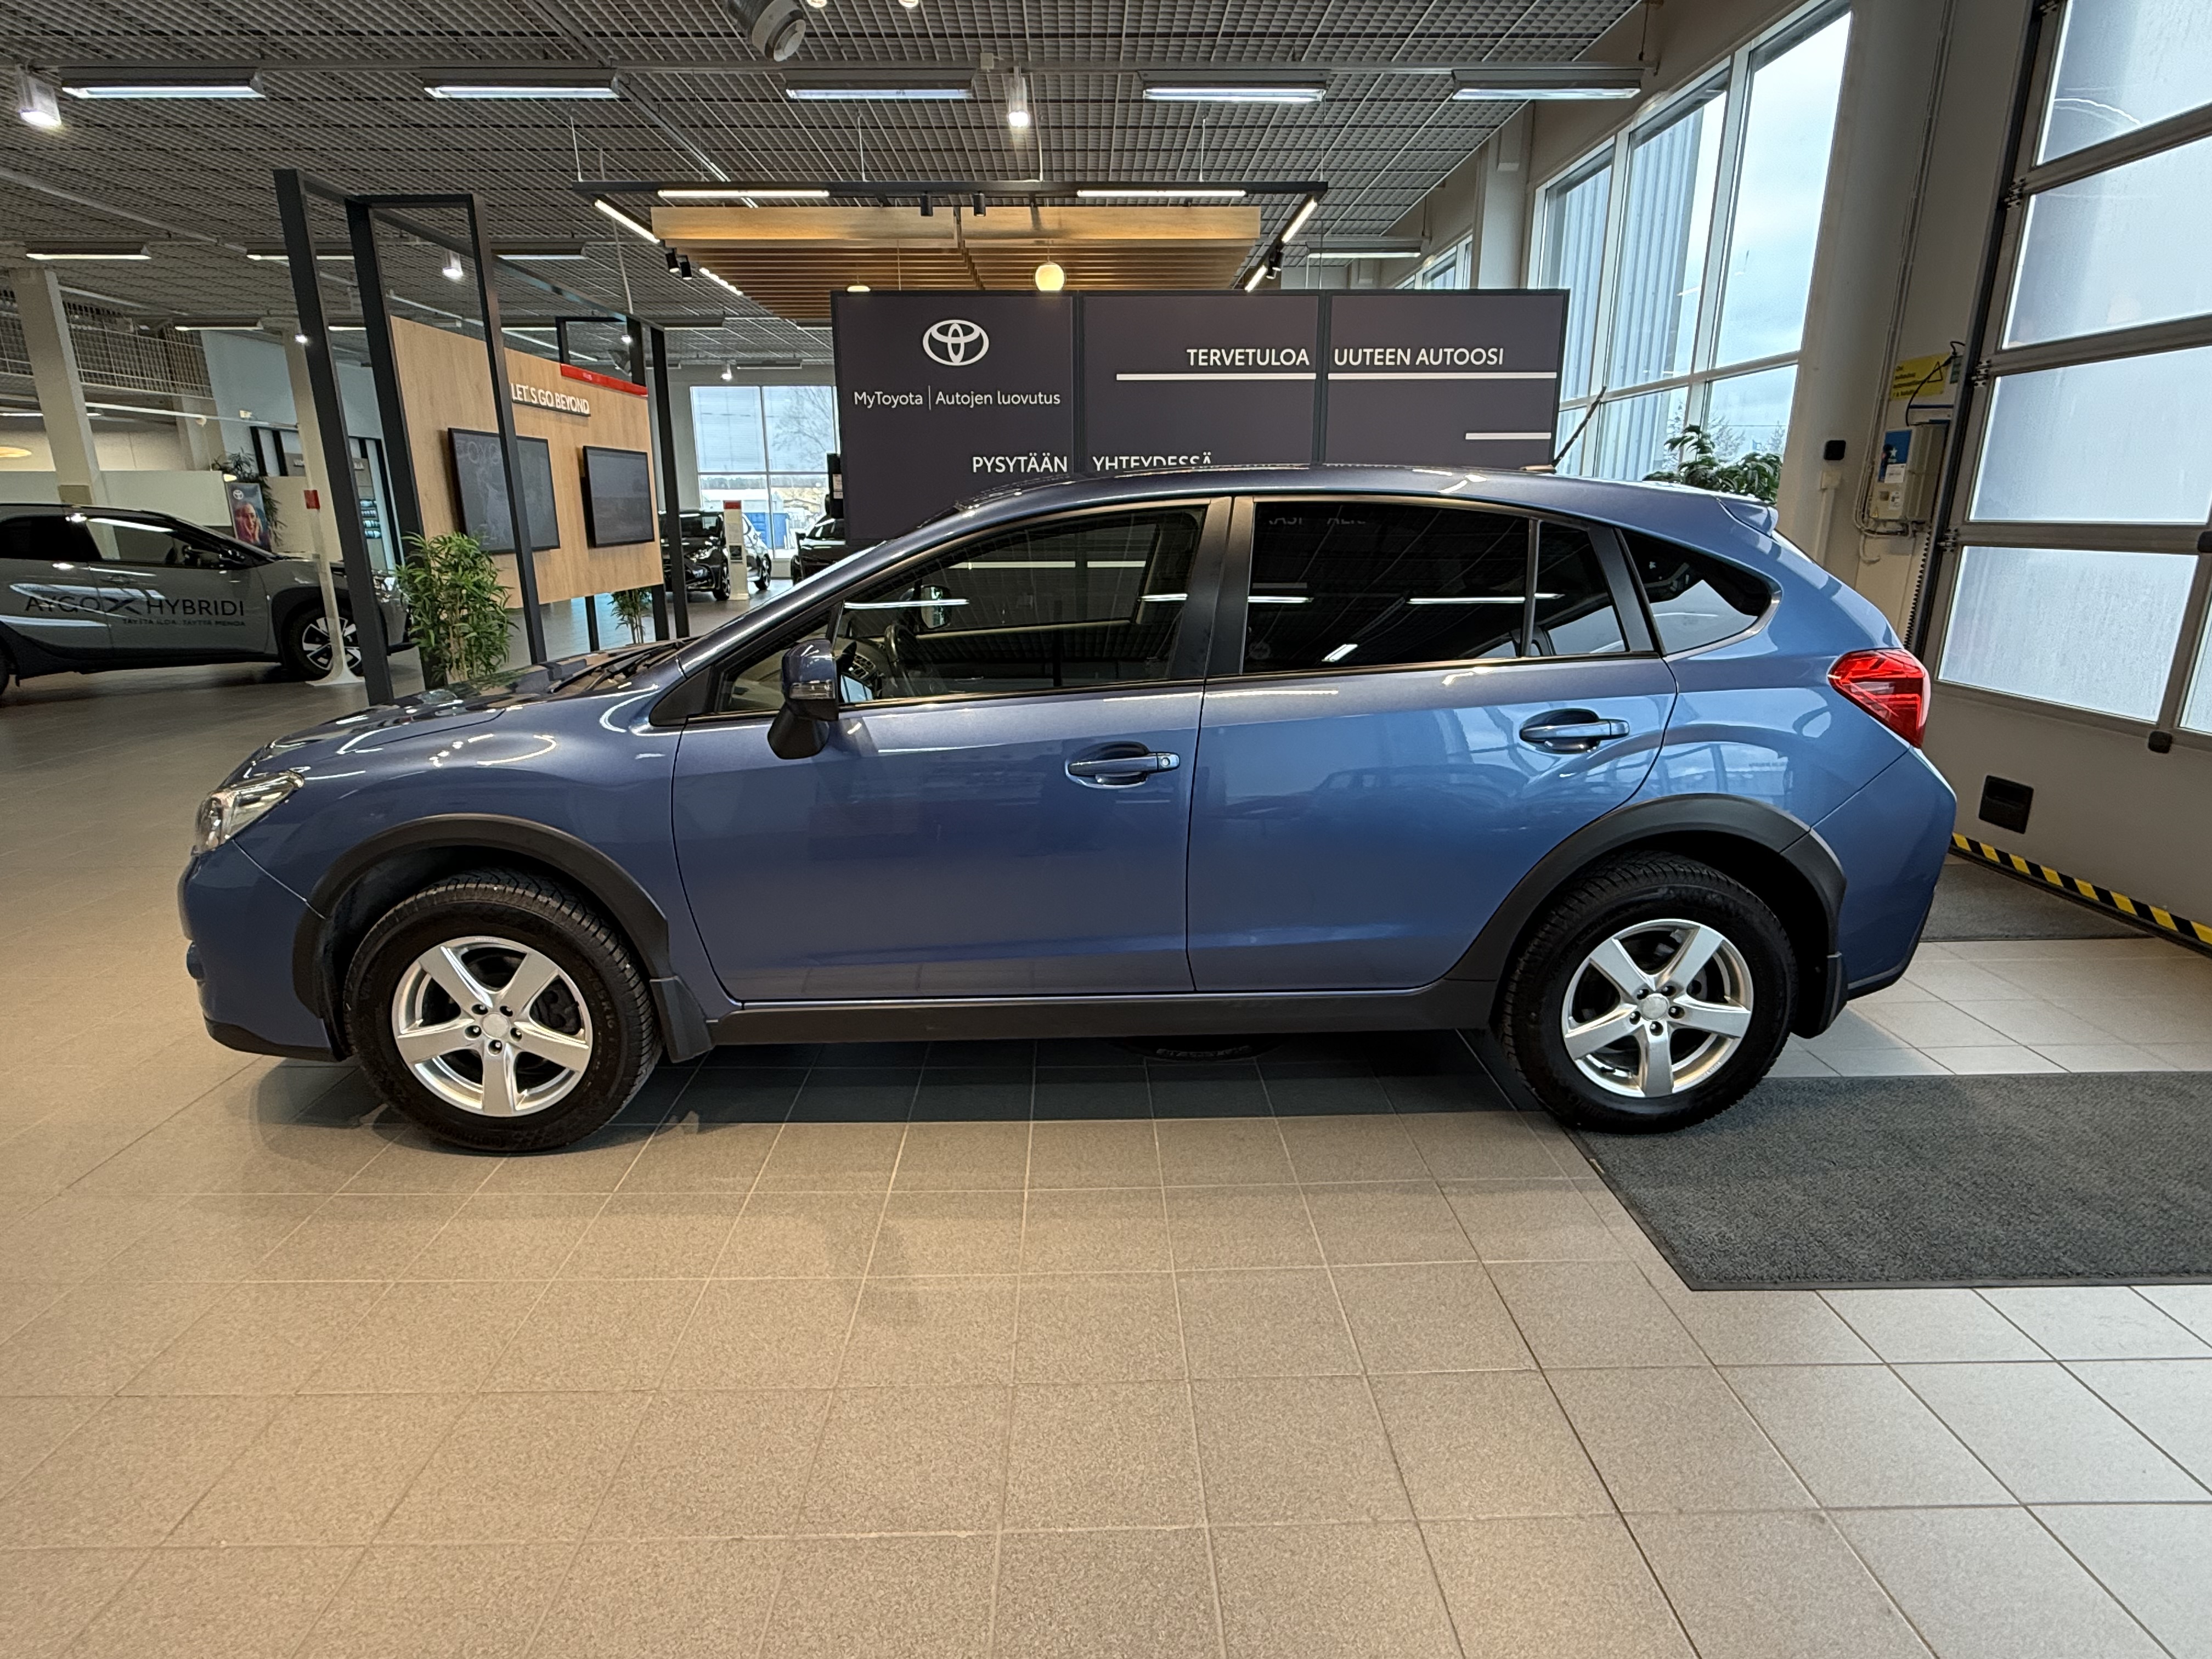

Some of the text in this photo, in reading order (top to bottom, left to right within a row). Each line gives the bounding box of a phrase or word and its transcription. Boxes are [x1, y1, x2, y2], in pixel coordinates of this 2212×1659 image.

[1186, 348, 1504, 366] TERVETULOA UUTEEN AUTOOSI
[538, 389, 555, 407] GO
[555, 393, 590, 414] BEYOND
[854, 391, 1060, 408] MyToyota Autojen luovutus
[973, 453, 1067, 472] PYSYTÄÄN
[147, 599, 244, 616] HYBRIDI
